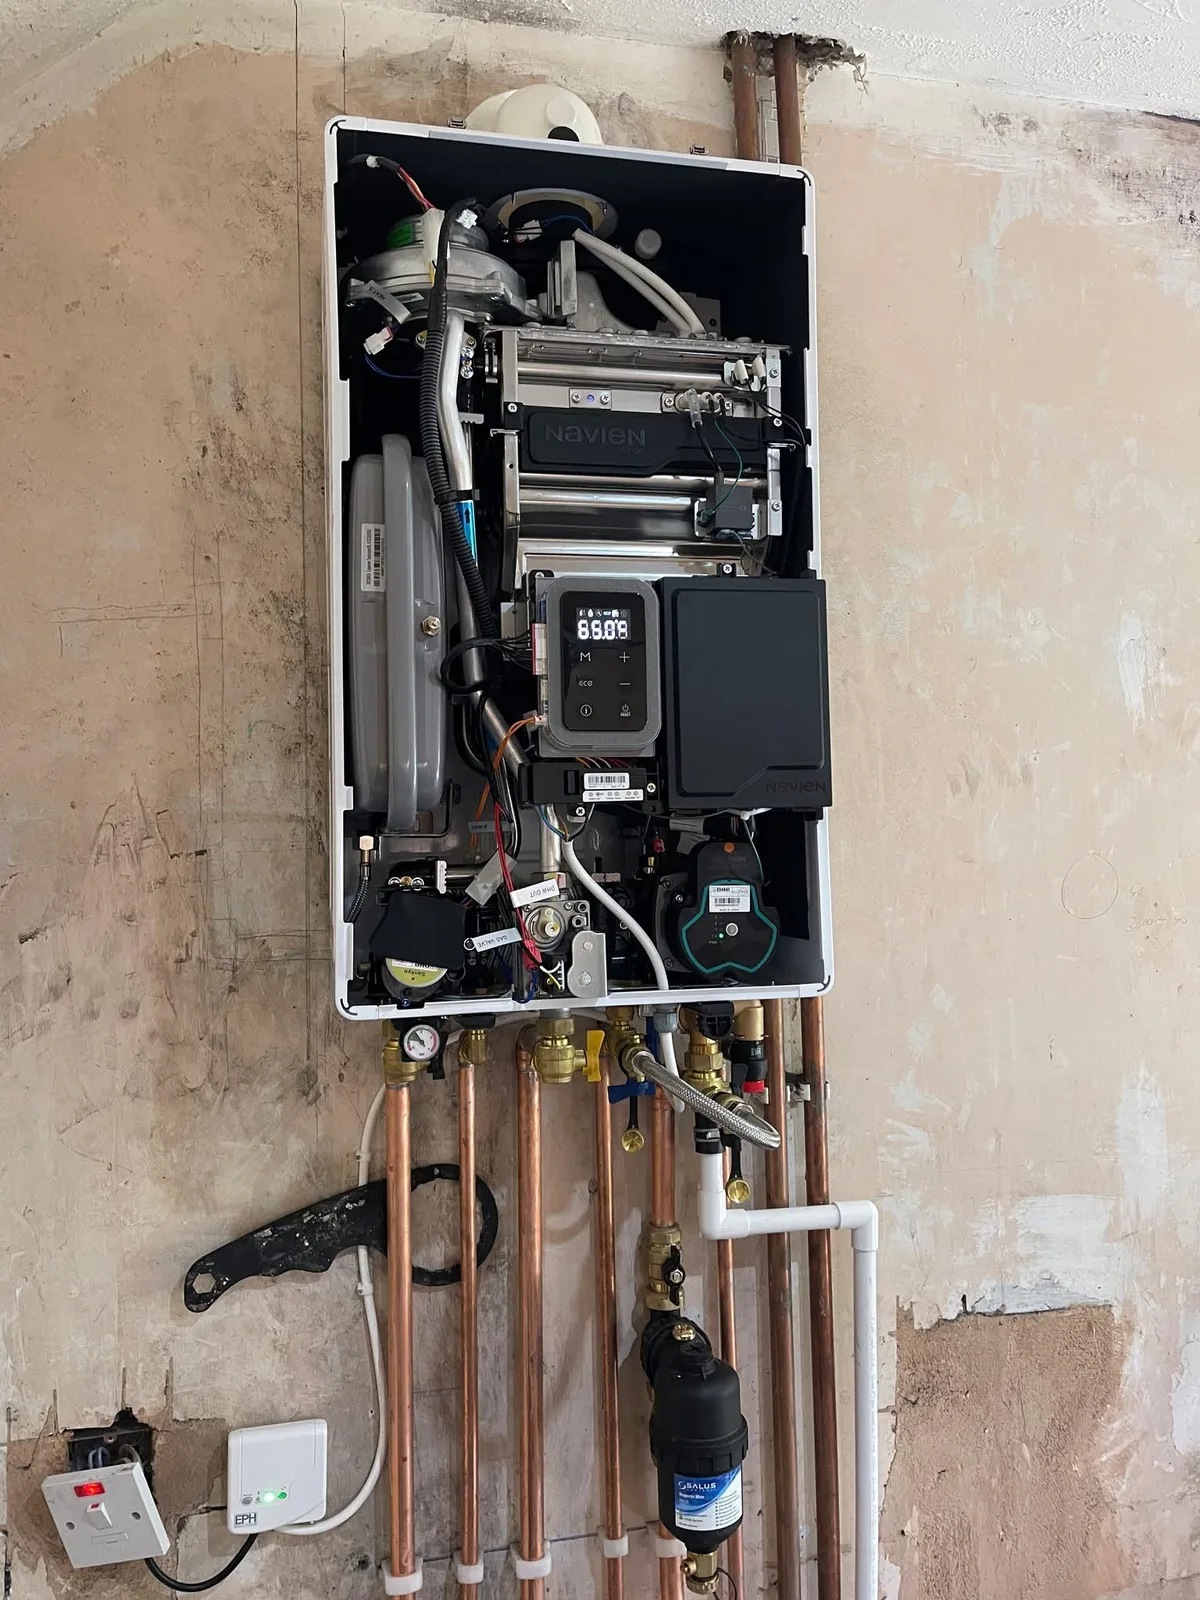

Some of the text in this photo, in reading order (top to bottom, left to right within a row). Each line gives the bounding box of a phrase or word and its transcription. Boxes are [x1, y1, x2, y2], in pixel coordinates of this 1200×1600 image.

[580, 652, 591, 662] M
[530, 890, 541, 898] OUT
[477, 937, 494, 947] VALVE
[686, 1482, 717, 1490] SALUS
[235, 1513, 257, 1525] EPH
